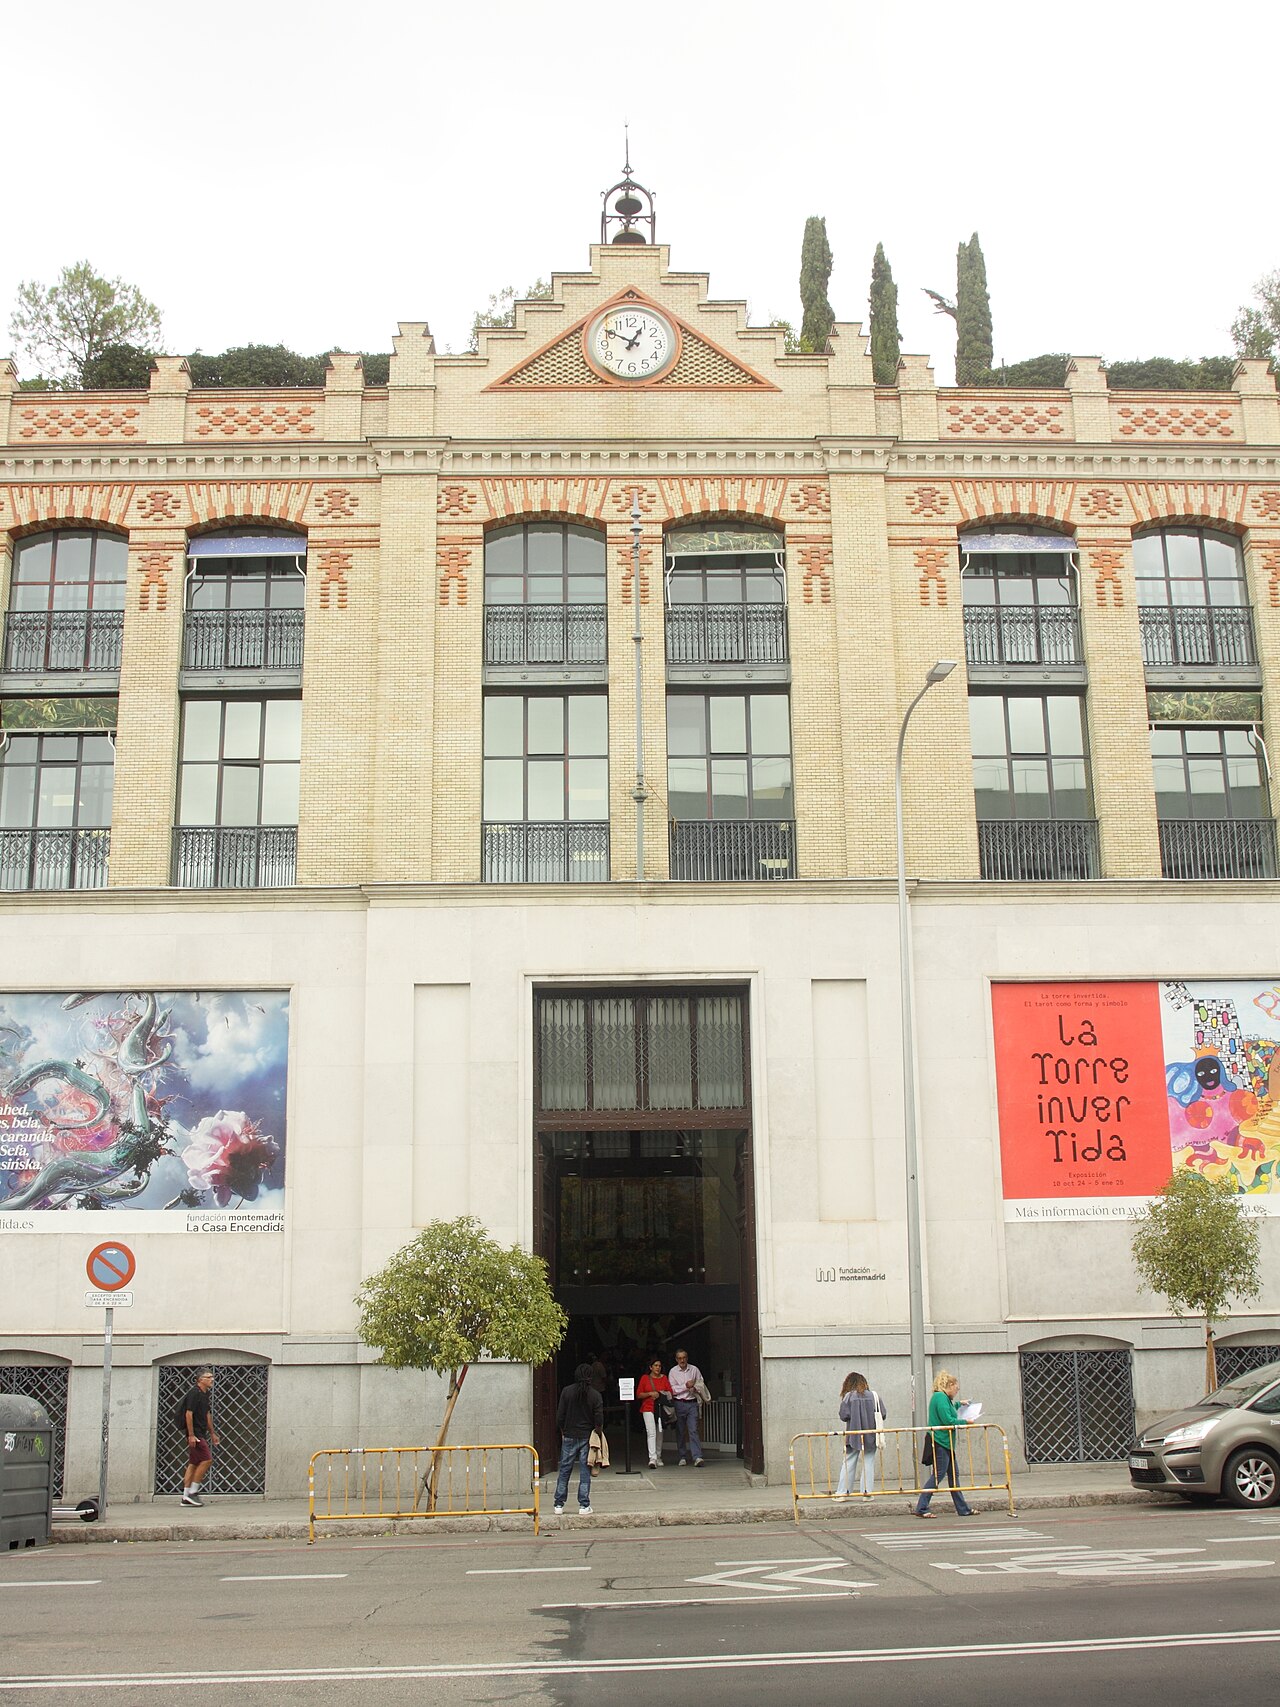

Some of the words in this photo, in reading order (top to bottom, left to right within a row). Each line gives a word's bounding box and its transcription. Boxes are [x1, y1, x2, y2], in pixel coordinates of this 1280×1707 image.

[615, 320, 622, 331] 11
[625, 317, 637, 328] 12
[643, 320, 646, 330] 1
[649, 327, 658, 338] 2
[600, 339, 609, 350] 9
[654, 339, 663, 350] 3
[604, 350, 613, 361] 8
[650, 350, 659, 361] 4
[615, 359, 624, 369] 7
[627, 362, 637, 372] 6
[641, 358, 650, 369] 5
[12, 1116, 41, 1129] bela,
[186, 1213, 227, 1221] fundación
[1015, 1206, 1040, 1218] Más
[1041, 1205, 1109, 1217] información
[1111, 1206, 1126, 1216] en
[186, 1223, 199, 1232] La
[201, 1222, 227, 1232] Casa
[839, 1266, 871, 1274] fundación
